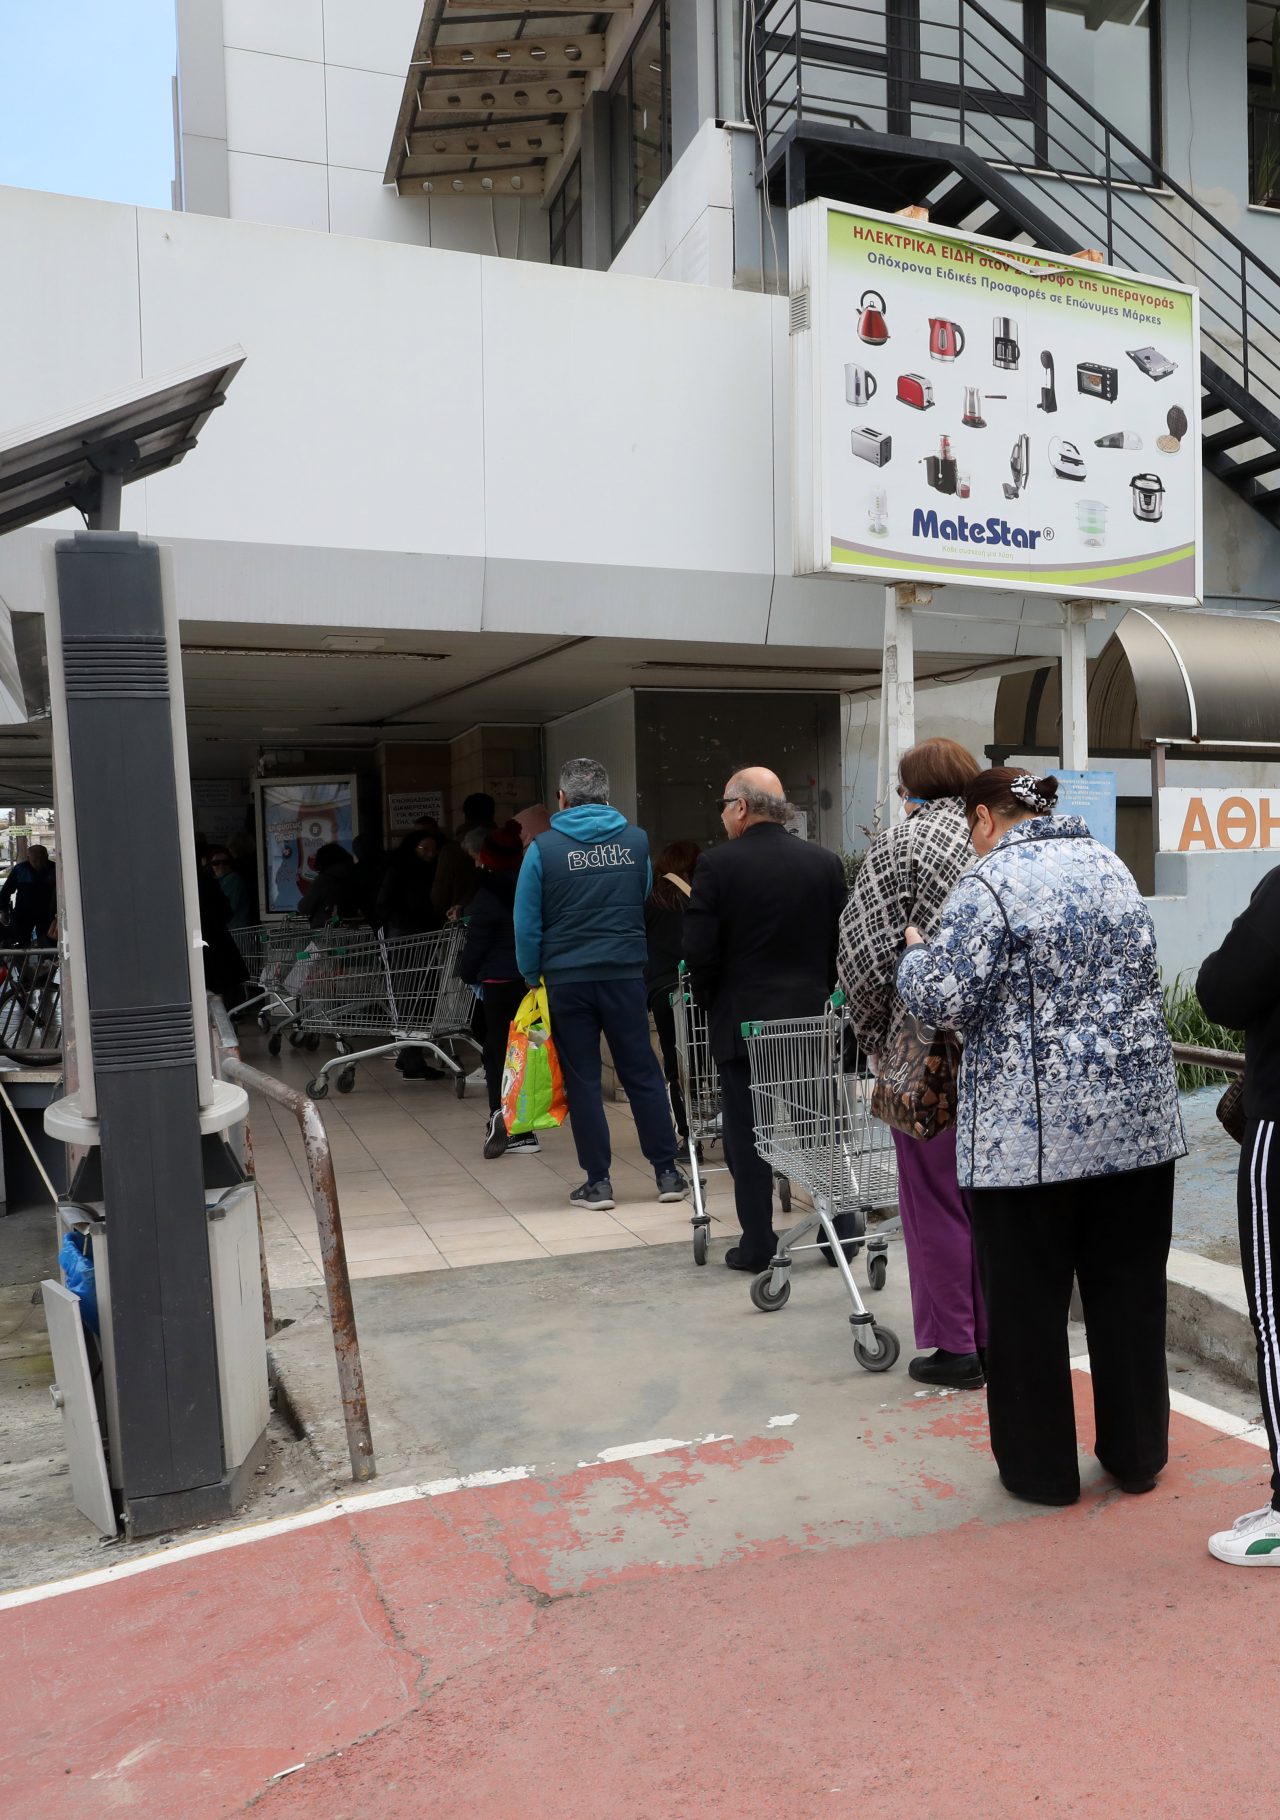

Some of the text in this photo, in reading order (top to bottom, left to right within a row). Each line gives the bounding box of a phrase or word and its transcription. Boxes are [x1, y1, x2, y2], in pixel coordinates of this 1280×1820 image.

[853, 225, 936, 257] ΗΛΕΚΤΡΙΚΑ
[941, 245, 974, 265] ΕΙΔΗ
[1078, 279, 1098, 292] της
[1102, 287, 1175, 310] υπεραγοράς
[867, 251, 1162, 326] Ολόχρονα Ειδικές Προσφορές σε Επώνυμες Μάρκες
